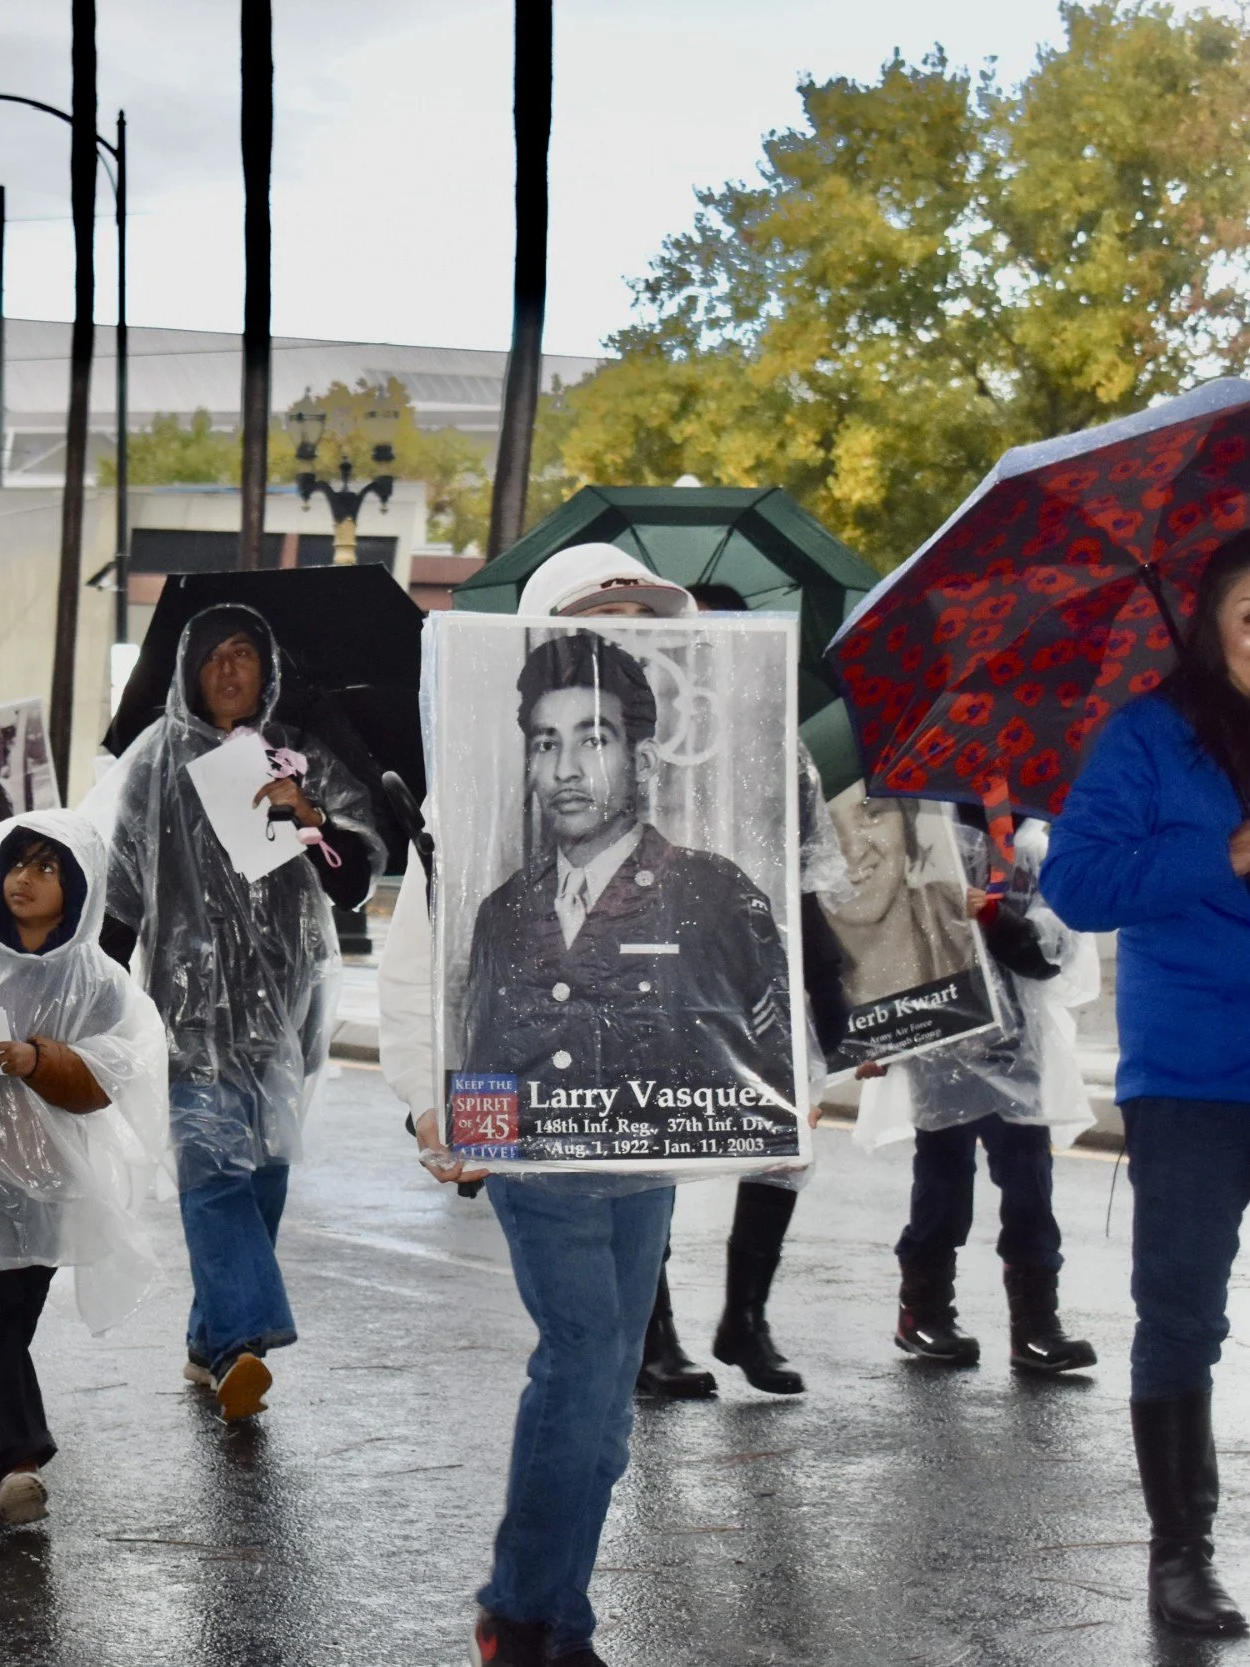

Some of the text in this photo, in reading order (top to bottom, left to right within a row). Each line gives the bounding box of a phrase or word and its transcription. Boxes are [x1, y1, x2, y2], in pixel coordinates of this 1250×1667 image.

[894, 983, 959, 1018] Kwart
[870, 1020, 933, 1045] Army Air Force
[455, 1080, 513, 1090] KEEP THE
[457, 1097, 511, 1112] SPIRIT
[527, 1080, 777, 1117] Larry Vasquez
[458, 1119, 473, 1128] OF
[534, 1117, 579, 1134] 148th
[583, 1117, 613, 1134] Inf.
[667, 1116, 704, 1133] 37th
[707, 1116, 738, 1132] Inf.
[549, 1140, 590, 1158] Aug.
[612, 1139, 650, 1155] 1922
[662, 1138, 697, 1156] Jan.
[699, 1138, 724, 1155] 11,
[726, 1137, 765, 1152] 2003
